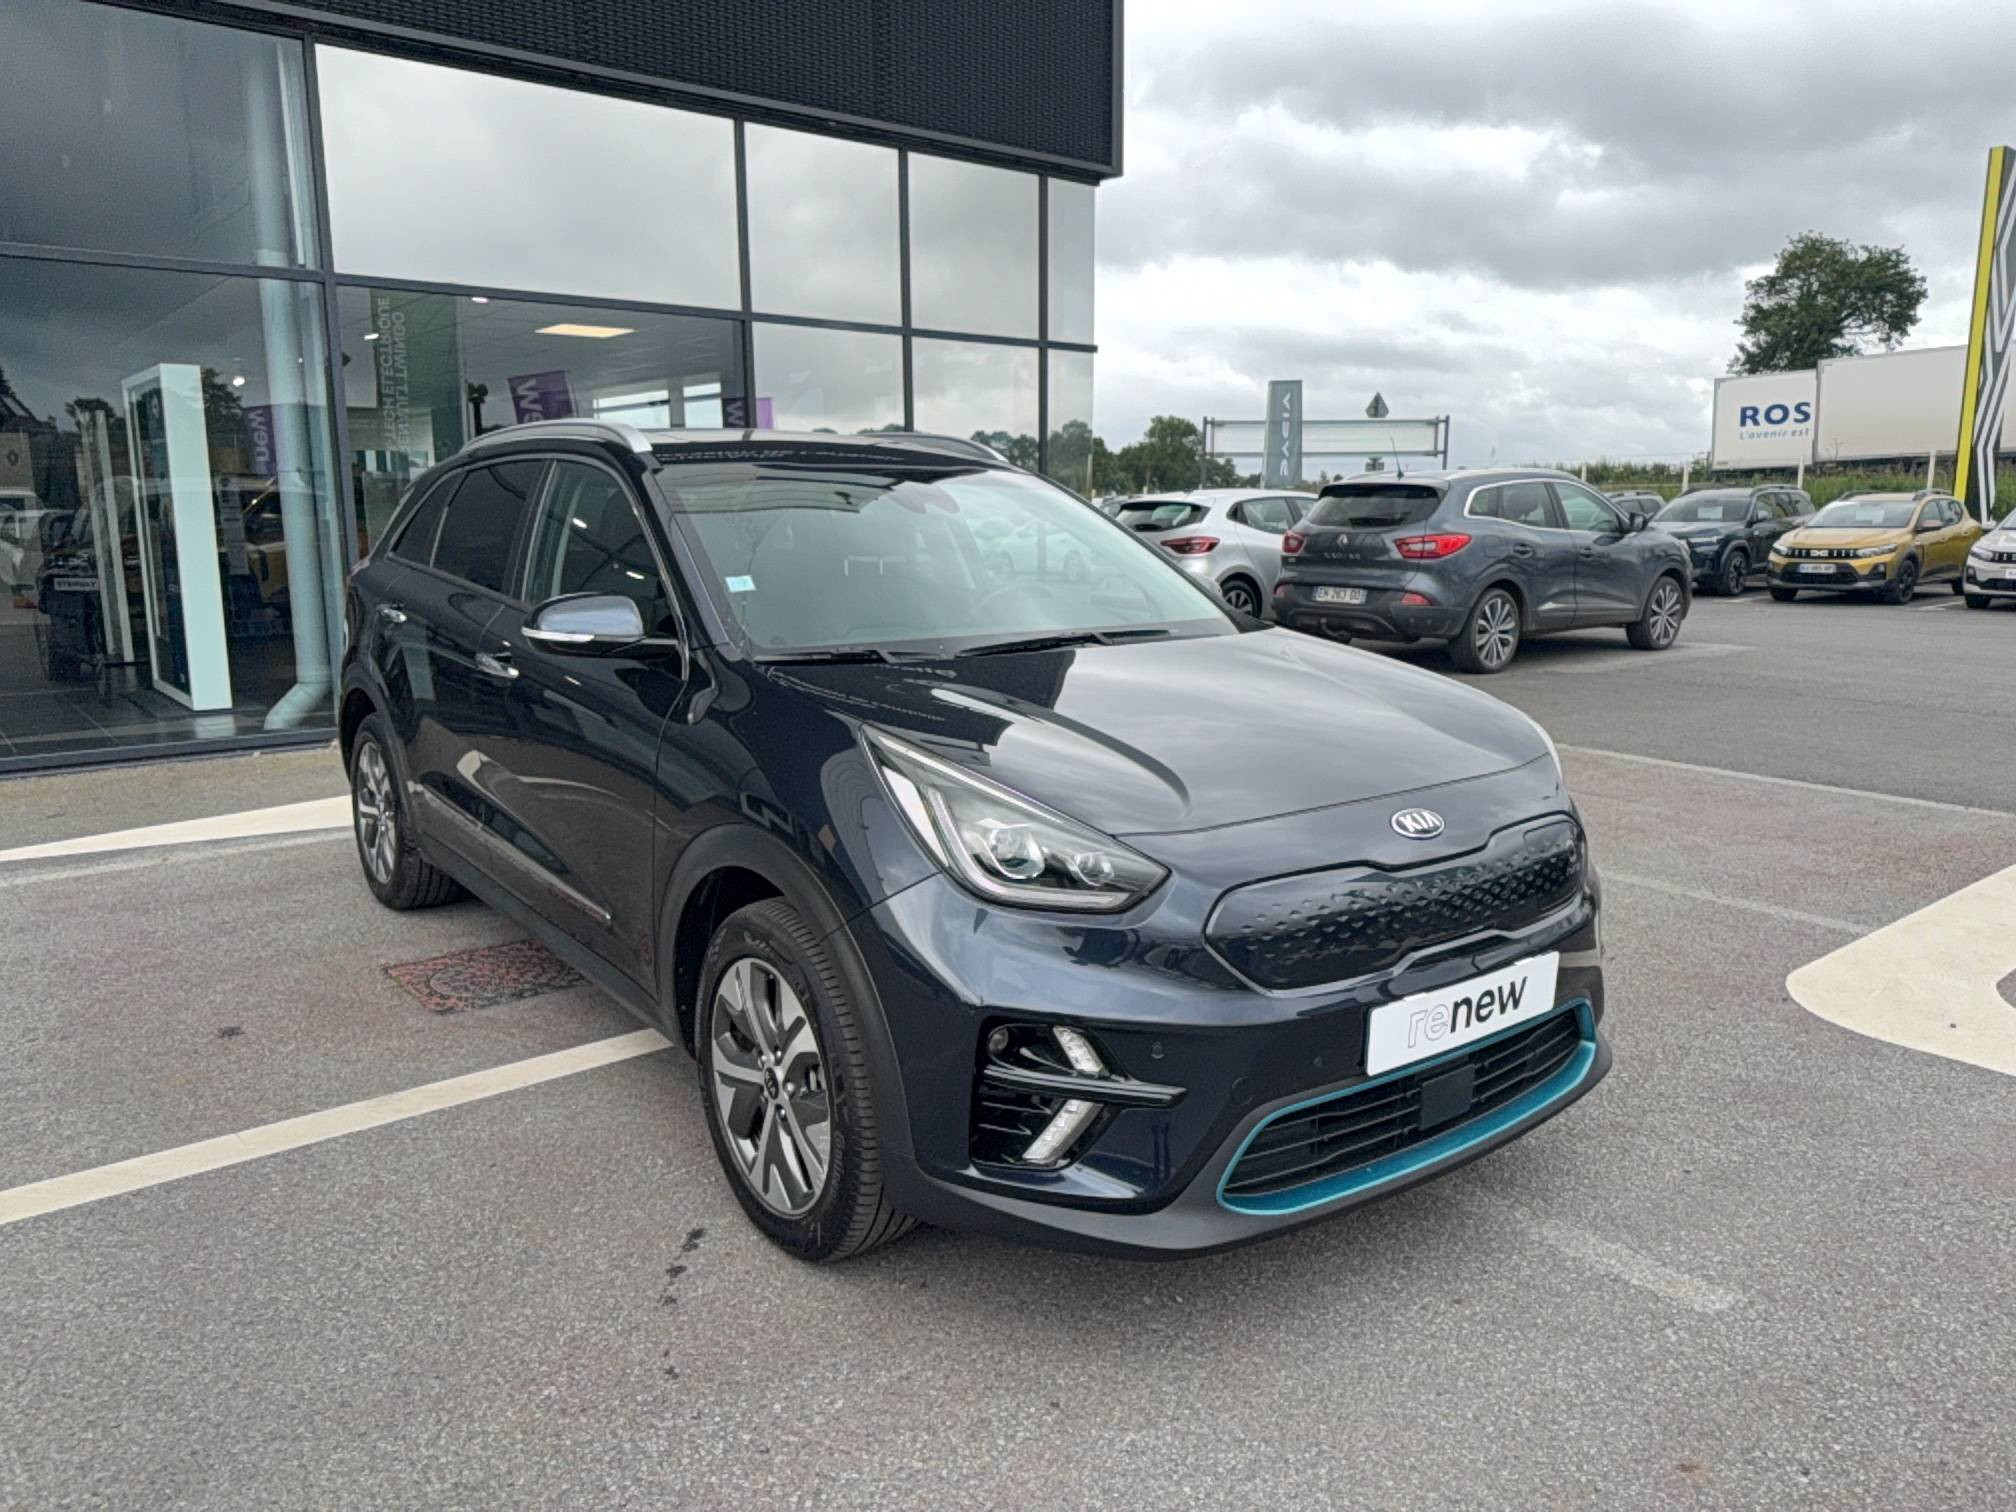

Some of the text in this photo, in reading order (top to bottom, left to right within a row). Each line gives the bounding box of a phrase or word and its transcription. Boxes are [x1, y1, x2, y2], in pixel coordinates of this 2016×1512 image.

[1739, 401, 1811, 427] ROS
[1280, 392, 1291, 476] DACIA
[1740, 427, 1809, 441] L'avenir est
[1399, 812, 1441, 832] KIA
[1408, 976, 1528, 1049] renew
